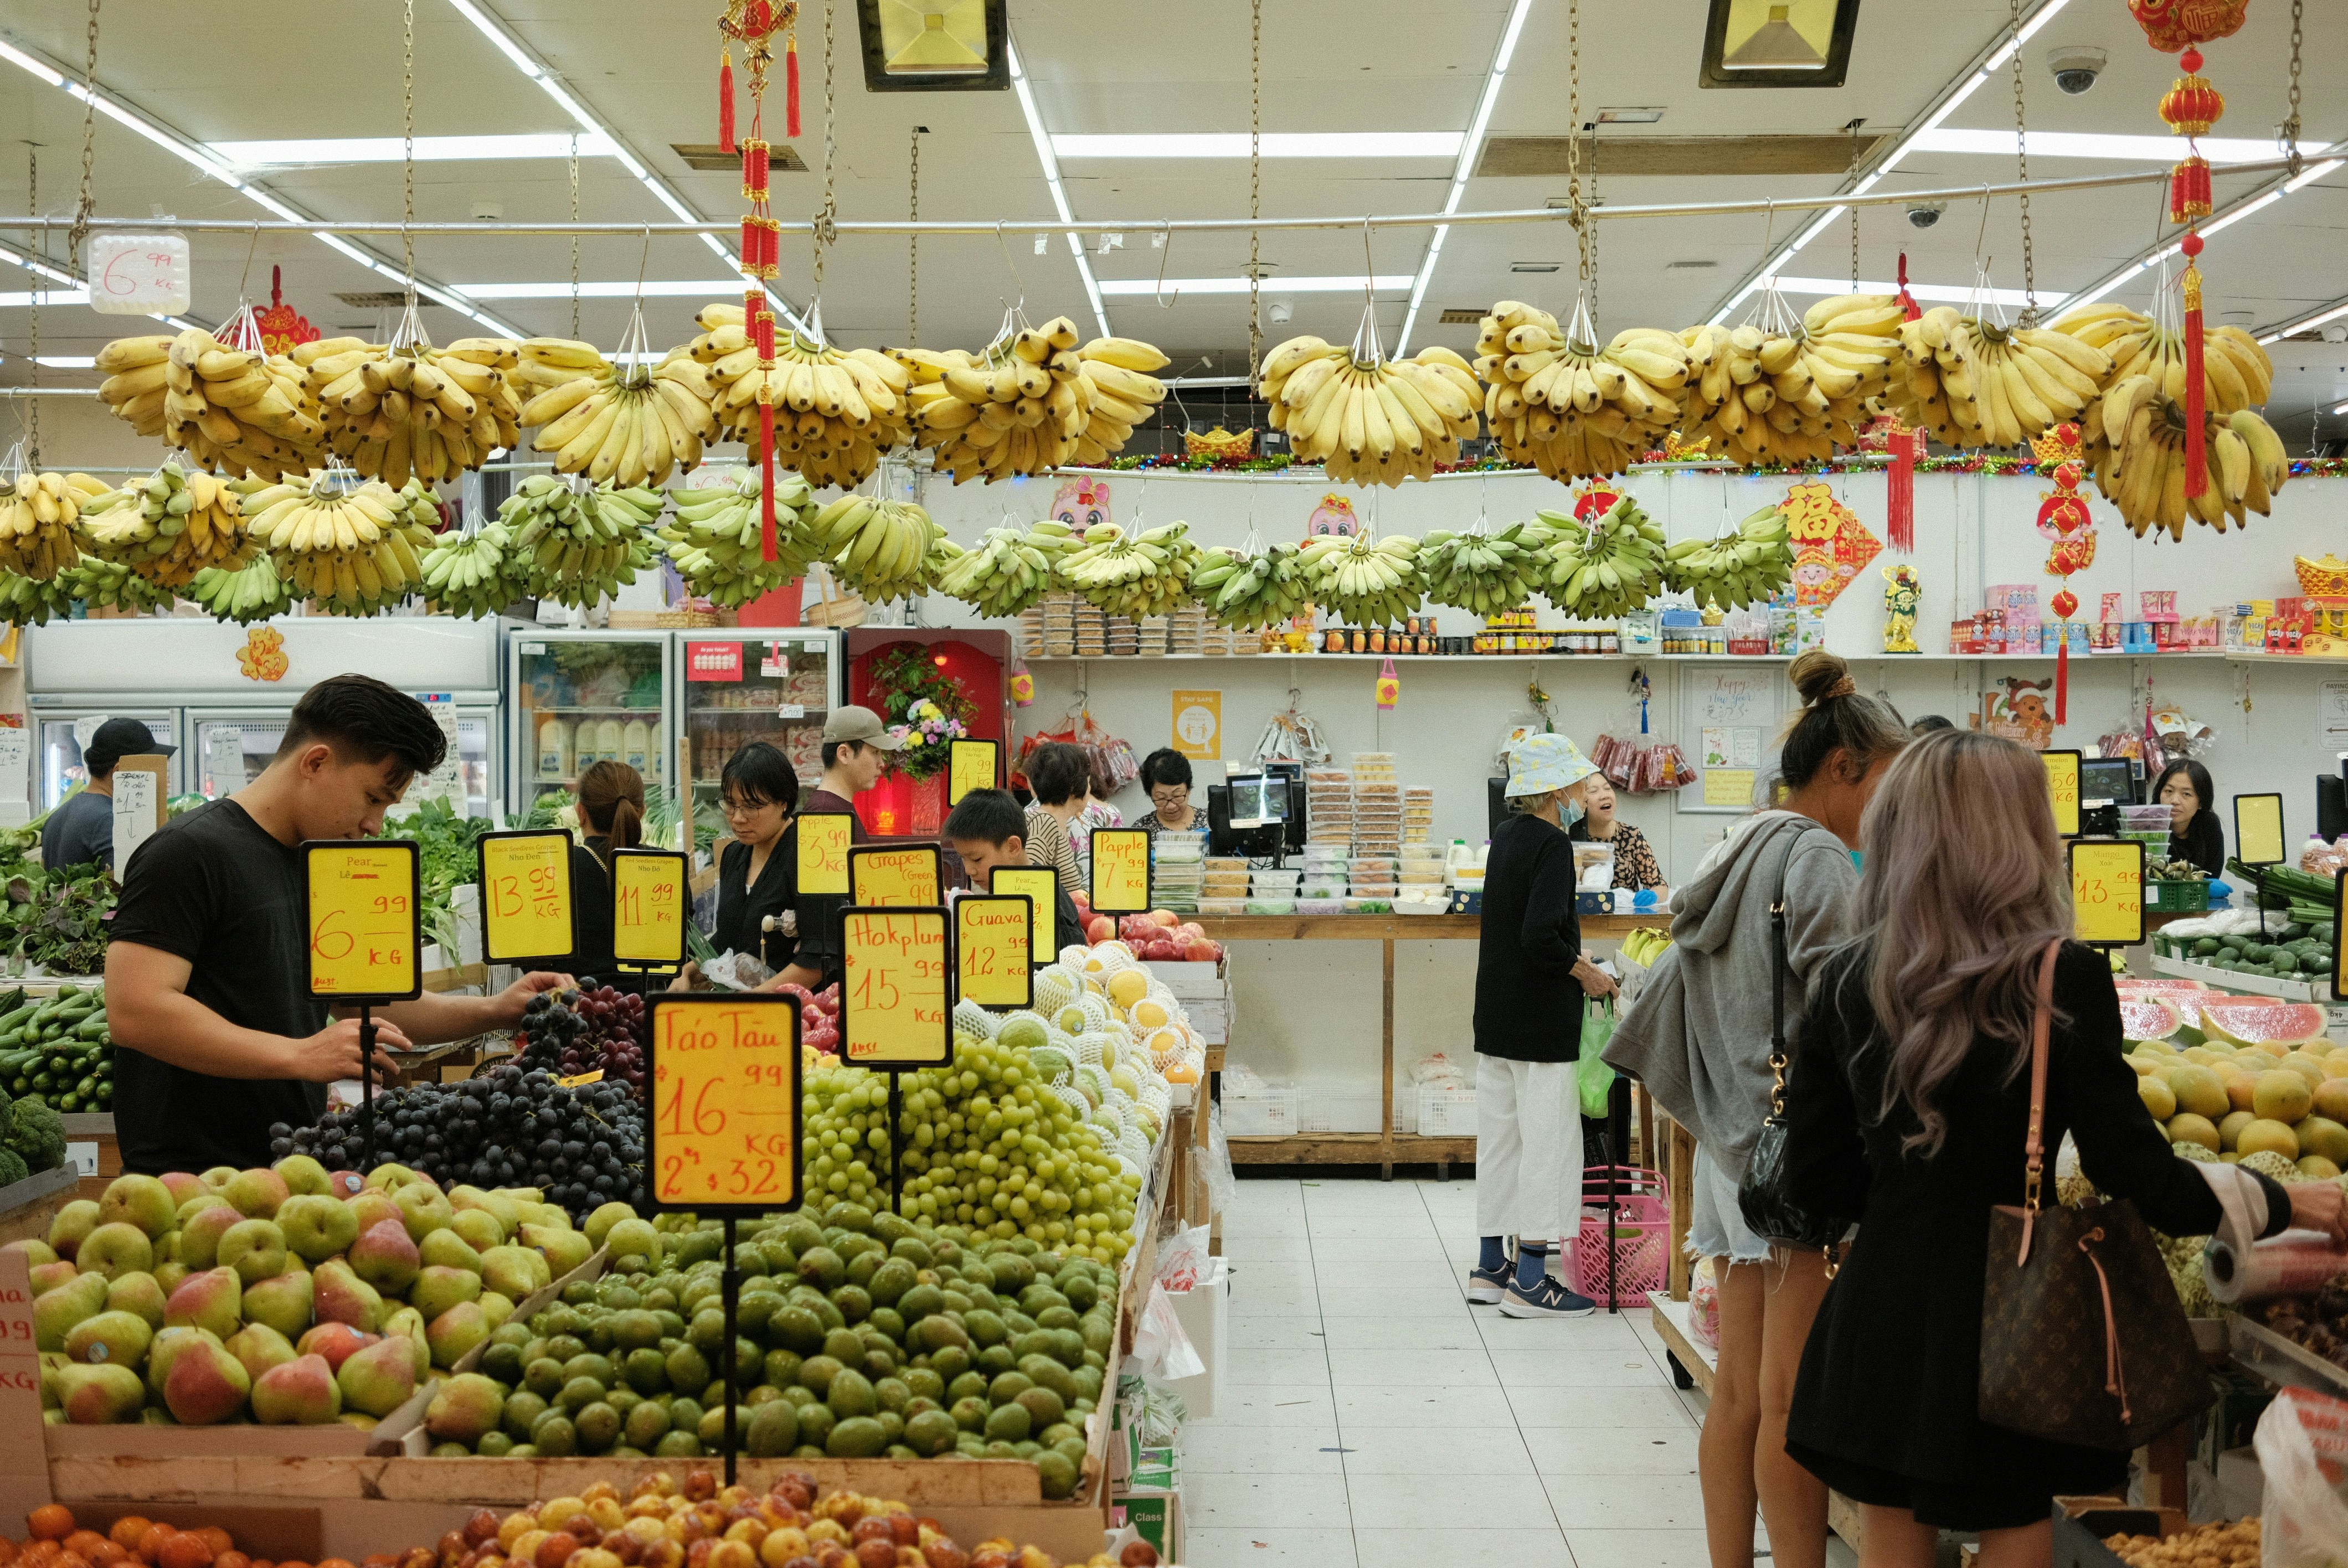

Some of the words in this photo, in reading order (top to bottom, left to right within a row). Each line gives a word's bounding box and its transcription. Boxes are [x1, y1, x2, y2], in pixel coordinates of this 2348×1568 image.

[104, 249, 137, 295] 6
[146, 253, 171, 267] 99
[1779, 484, 1840, 540] 福
[2268, 630, 2284, 638] POCKY
[2286, 630, 2303, 639] POCKY
[1716, 674, 1750, 694] Happy
[955, 762, 969, 791] 4
[977, 760, 991, 772] 99
[977, 775, 992, 786] KG
[2056, 792, 2074, 803] KG
[799, 815, 832, 829] Apple
[509, 844, 535, 852] Seedless
[798, 834, 806, 847] $
[805, 835, 825, 869] 3
[827, 829, 847, 848] 99
[1100, 833, 1145, 859] Papple
[2093, 851, 2120, 859] Mango
[346, 857, 372, 866] Pear
[825, 859, 847, 872] KG
[867, 853, 924, 873] Grapes
[902, 868, 936, 881] (Green)
[1101, 863, 1116, 889] 7
[1126, 859, 1145, 868] 99
[493, 875, 523, 917] 13
[529, 866, 556, 894] 99
[651, 884, 673, 902] 99
[857, 883, 867, 900] $
[1126, 879, 1144, 889] KG
[2078, 879, 2108, 904] 13
[2114, 871, 2141, 884] 99
[534, 902, 562, 919] KG
[657, 911, 672, 923] KG
[965, 904, 1024, 926] Guava
[1033, 902, 1042, 915] 9
[2118, 902, 2140, 914] KG
[311, 910, 354, 960] 6
[369, 896, 407, 914] 99
[368, 948, 403, 966] KG
[964, 947, 995, 978] 12
[1005, 937, 1028, 949] 99
[1007, 967, 1027, 977] KG
[853, 968, 900, 1012] 15
[911, 960, 945, 978] 99
[914, 1008, 945, 1025] KG
[656, 1009, 718, 1051] Táo
[658, 1076, 727, 1136] 16
[742, 1064, 782, 1087] 99
[745, 1133, 791, 1159] KG
[727, 1158, 780, 1195] 32
[1135, 1513, 1162, 1522] Class
